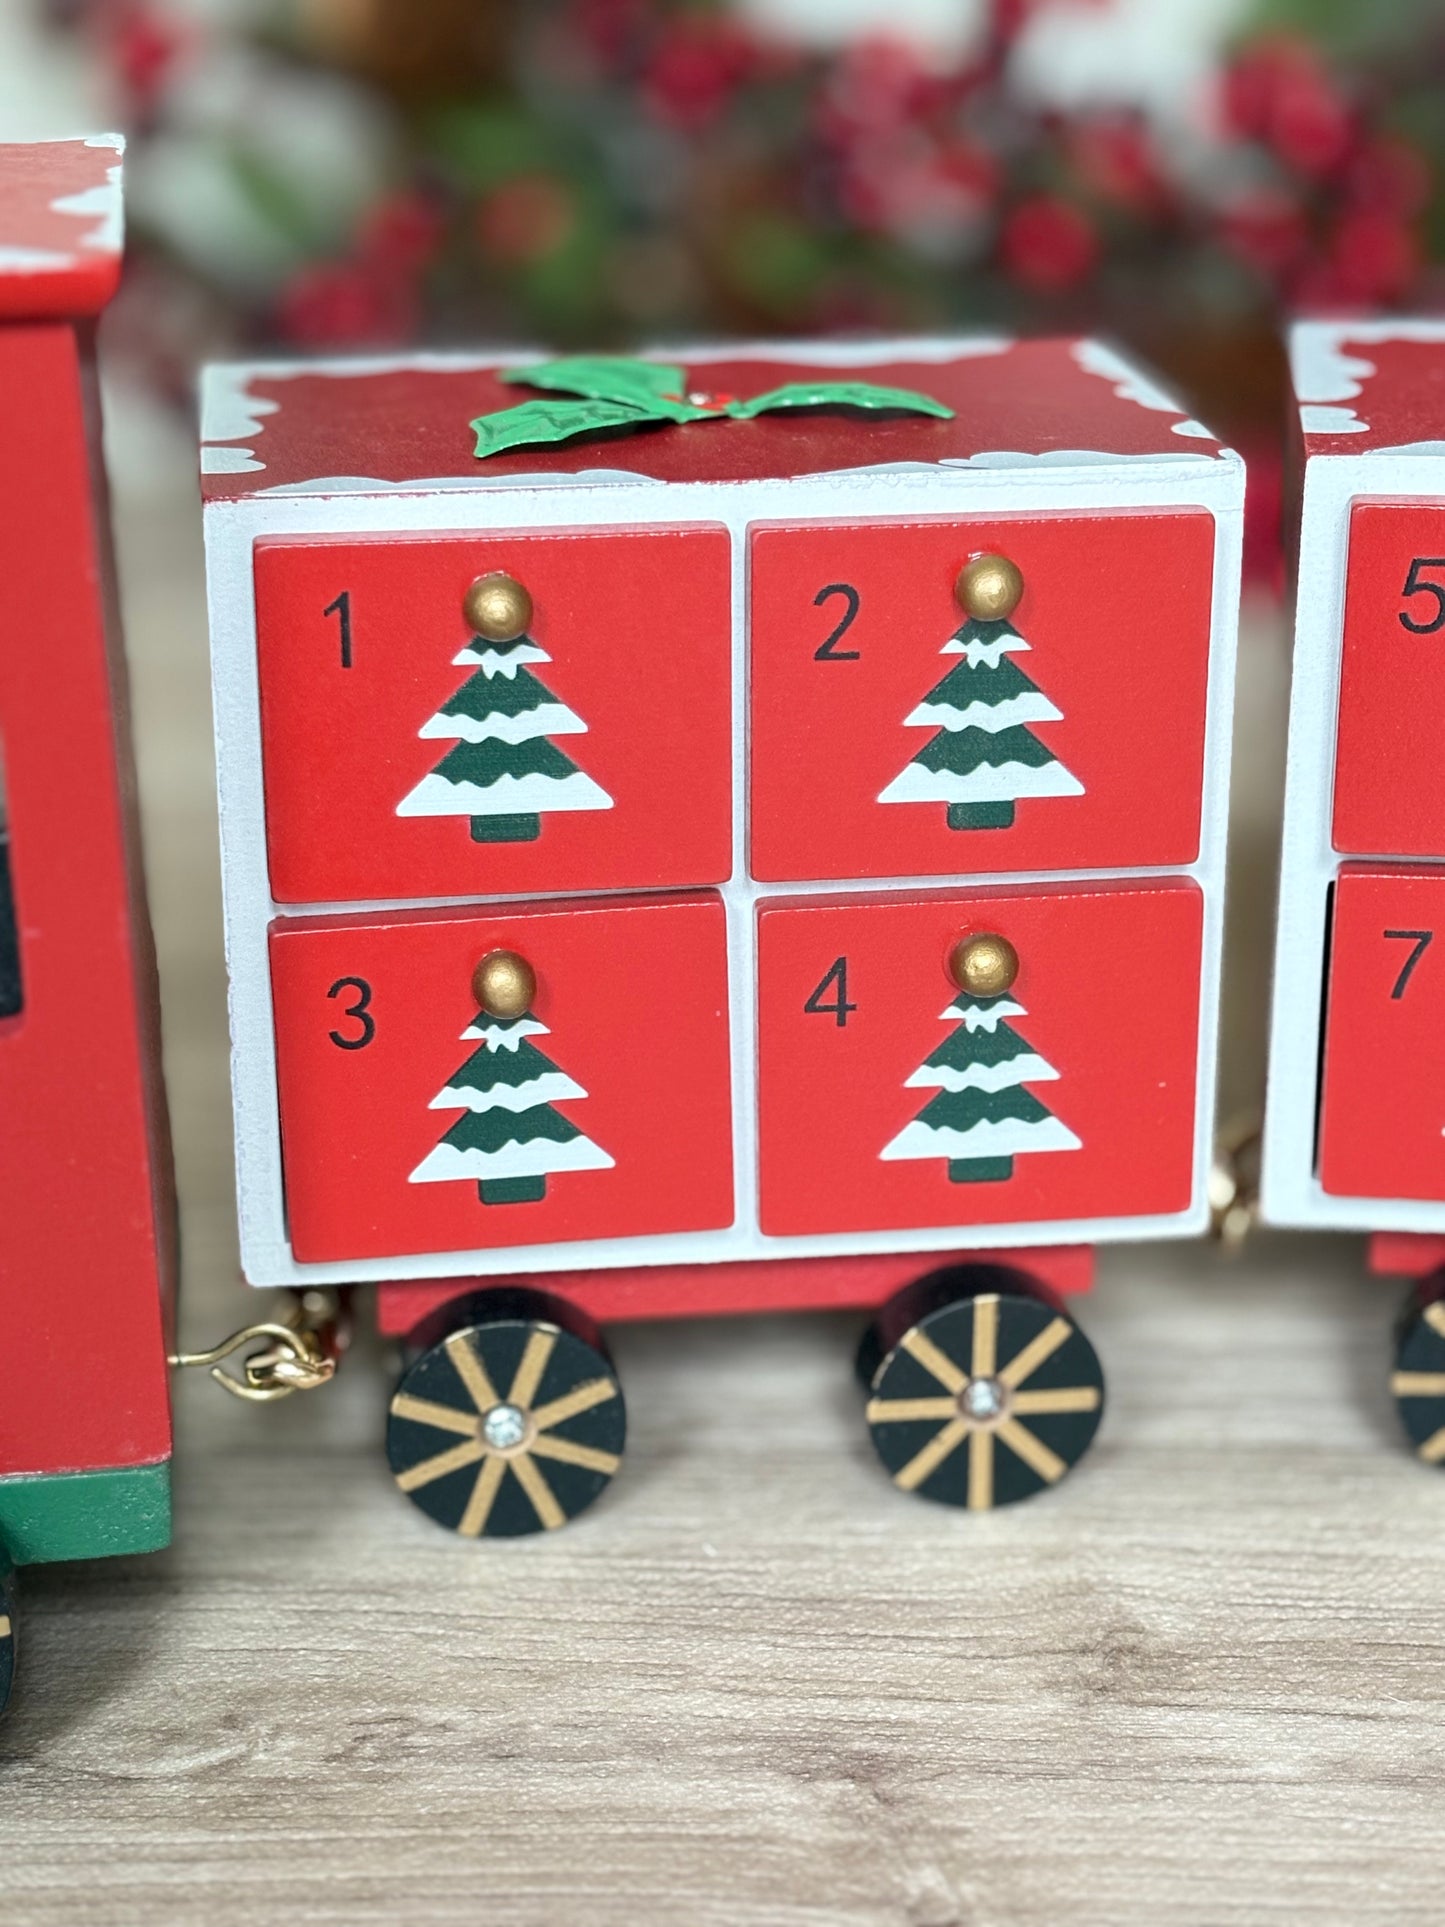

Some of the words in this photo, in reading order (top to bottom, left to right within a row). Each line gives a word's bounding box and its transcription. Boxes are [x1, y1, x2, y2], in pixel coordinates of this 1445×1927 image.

[322, 590, 353, 670] 1
[812, 582, 861, 662] 2
[1397, 556, 1445, 636] 5
[803, 955, 858, 1028] 4
[1382, 929, 1434, 1000] 7
[326, 975, 377, 1052] 3
